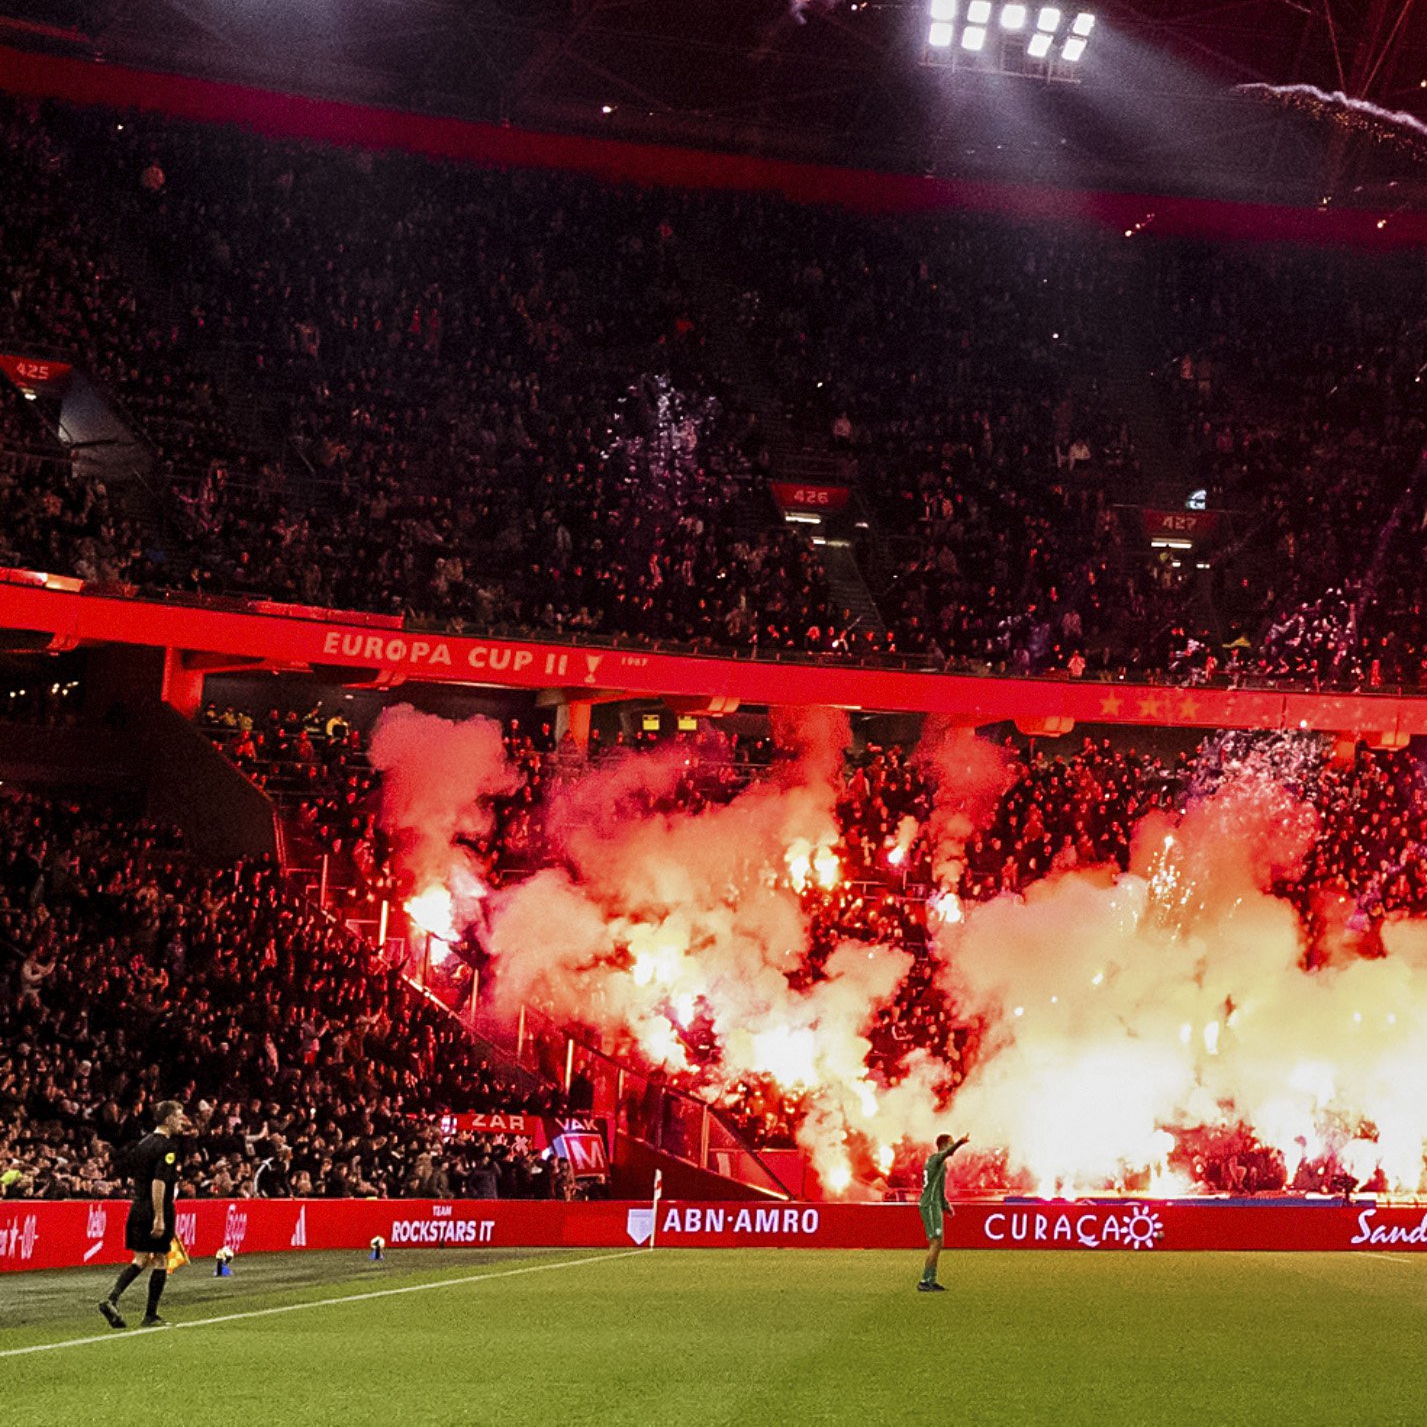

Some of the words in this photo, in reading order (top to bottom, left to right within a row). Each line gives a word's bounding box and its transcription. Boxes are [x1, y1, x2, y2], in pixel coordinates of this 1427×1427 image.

[16, 362, 49, 380] 425
[793, 489, 829, 505] 426
[1162, 515, 1197, 530] 427
[323, 631, 452, 666] EUROPA
[468, 646, 534, 672] CUP
[545, 653, 568, 676] II
[472, 1114, 525, 1130] ZAR
[555, 1118, 599, 1131] VAK
[432, 1205, 453, 1216] TEAM
[391, 1220, 477, 1243] ROCKSTARS
[479, 1220, 495, 1243] IT
